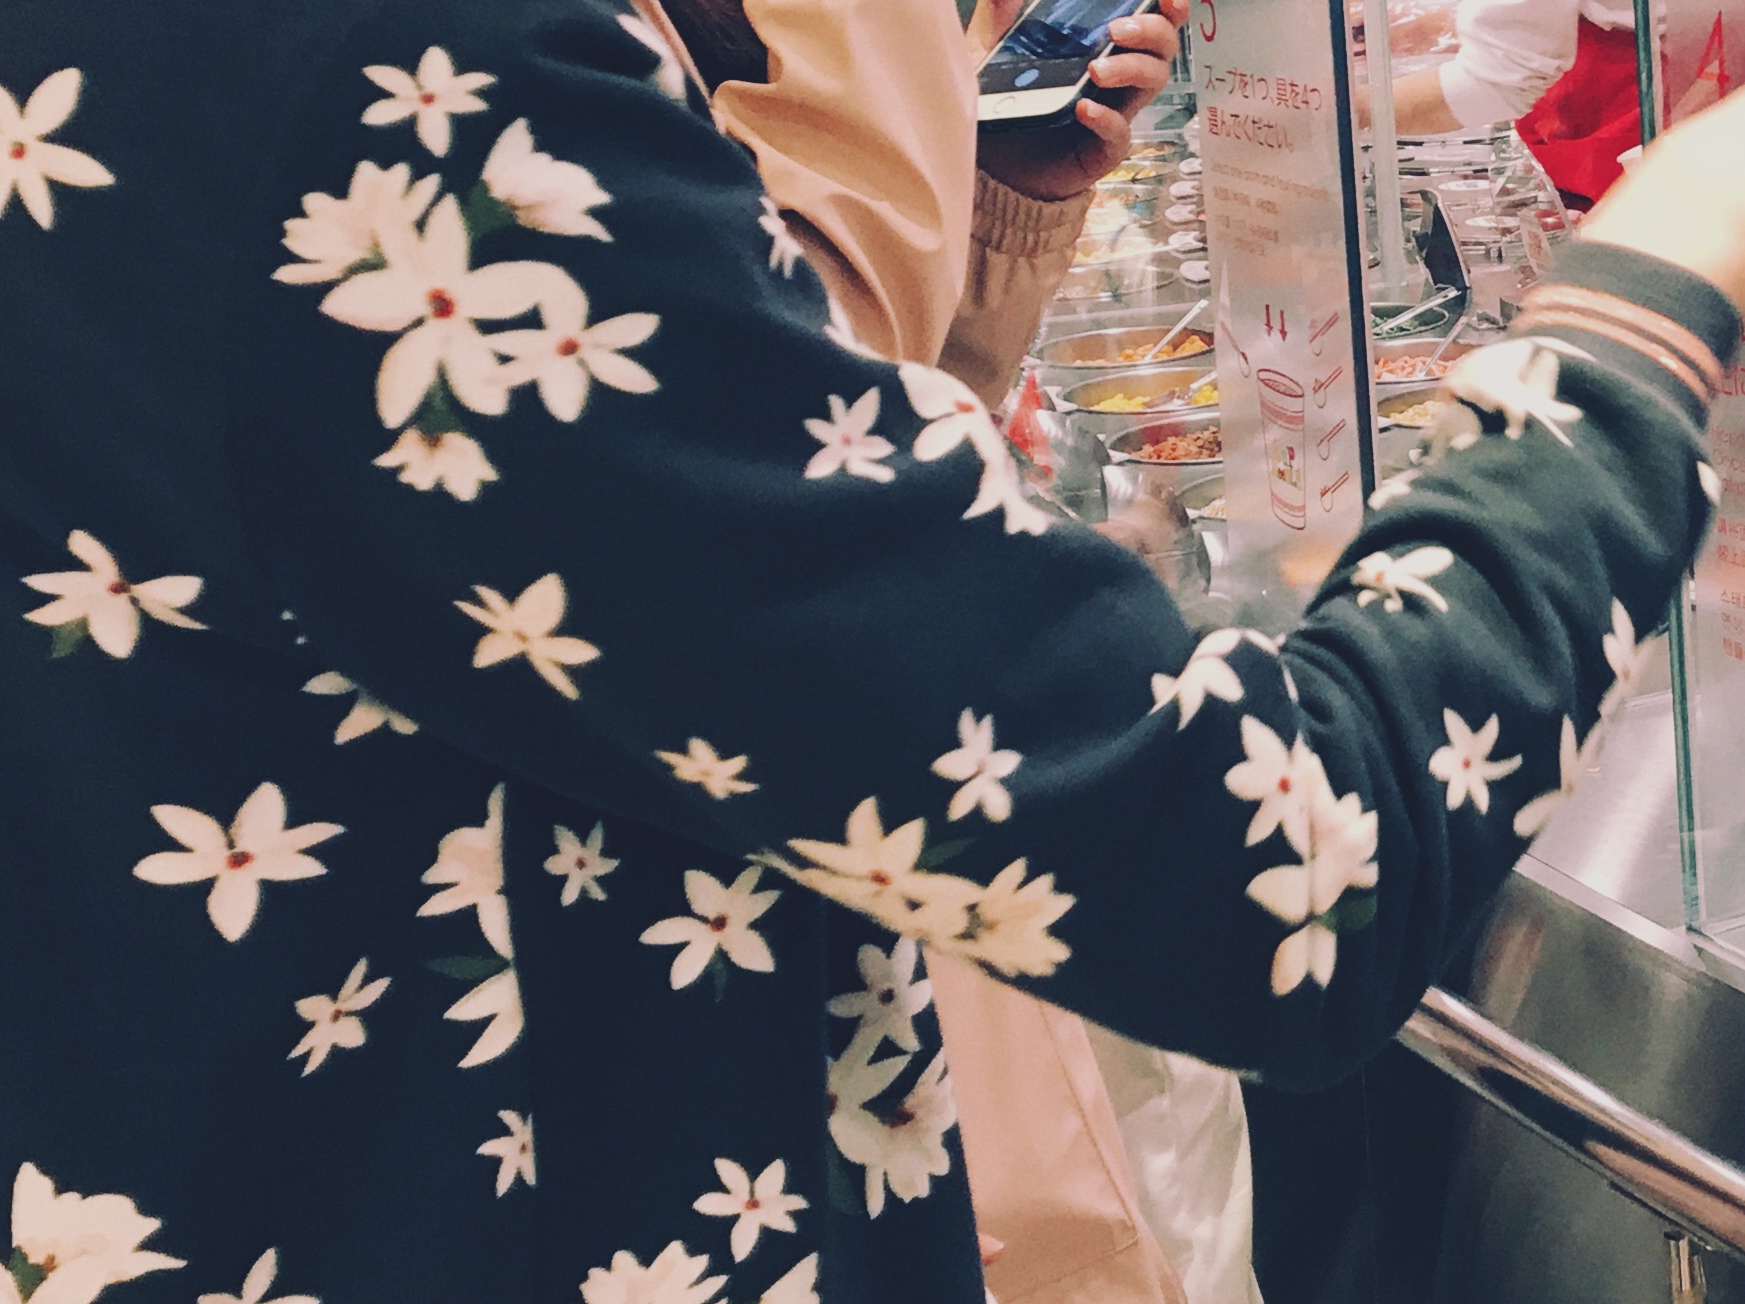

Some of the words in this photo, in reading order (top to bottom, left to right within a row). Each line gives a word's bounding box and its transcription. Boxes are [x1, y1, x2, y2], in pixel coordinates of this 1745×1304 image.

[1204, 65, 1322, 111] スープを1つ、具を4つ
